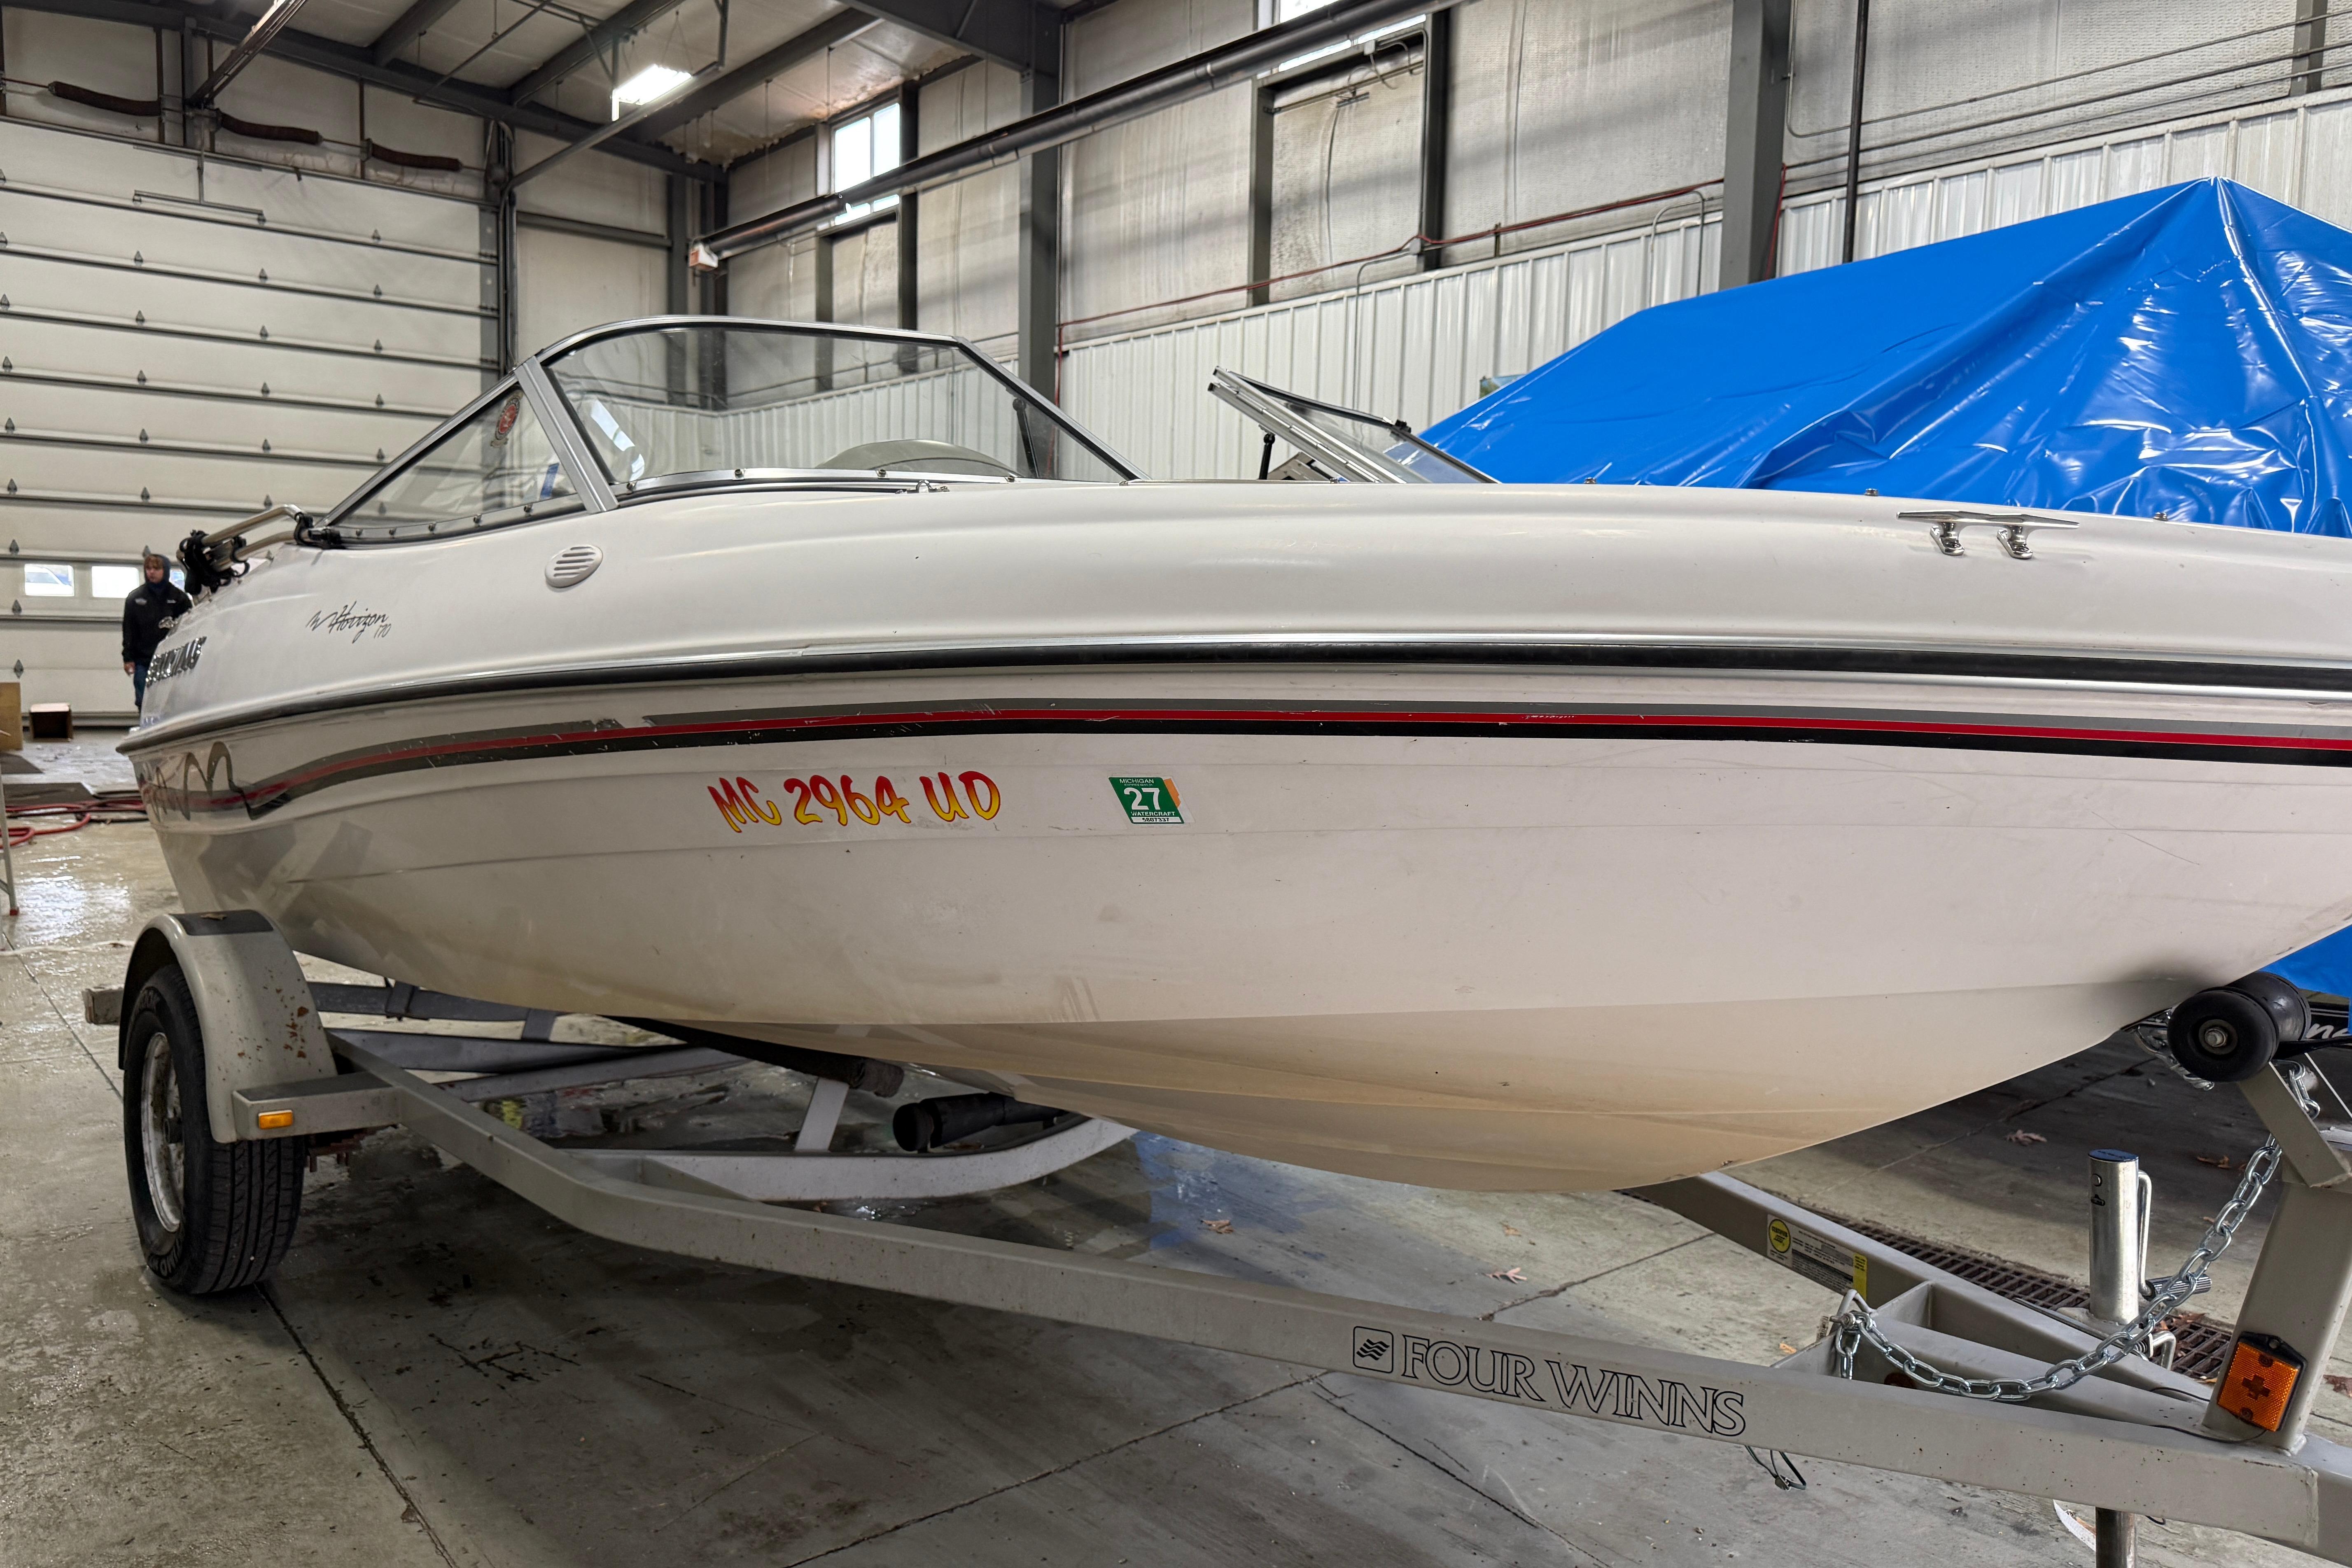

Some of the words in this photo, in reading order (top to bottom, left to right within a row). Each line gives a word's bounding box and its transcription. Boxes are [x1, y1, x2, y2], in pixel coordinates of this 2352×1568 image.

[373, 623, 392, 639] 170
[707, 776, 782, 833] MC
[784, 774, 912, 826] 2964
[919, 770, 1001, 822] UD
[1124, 787, 1161, 810] 27
[1402, 1334, 1547, 1402] FOUR
[1544, 1359, 1746, 1437] WINNS
